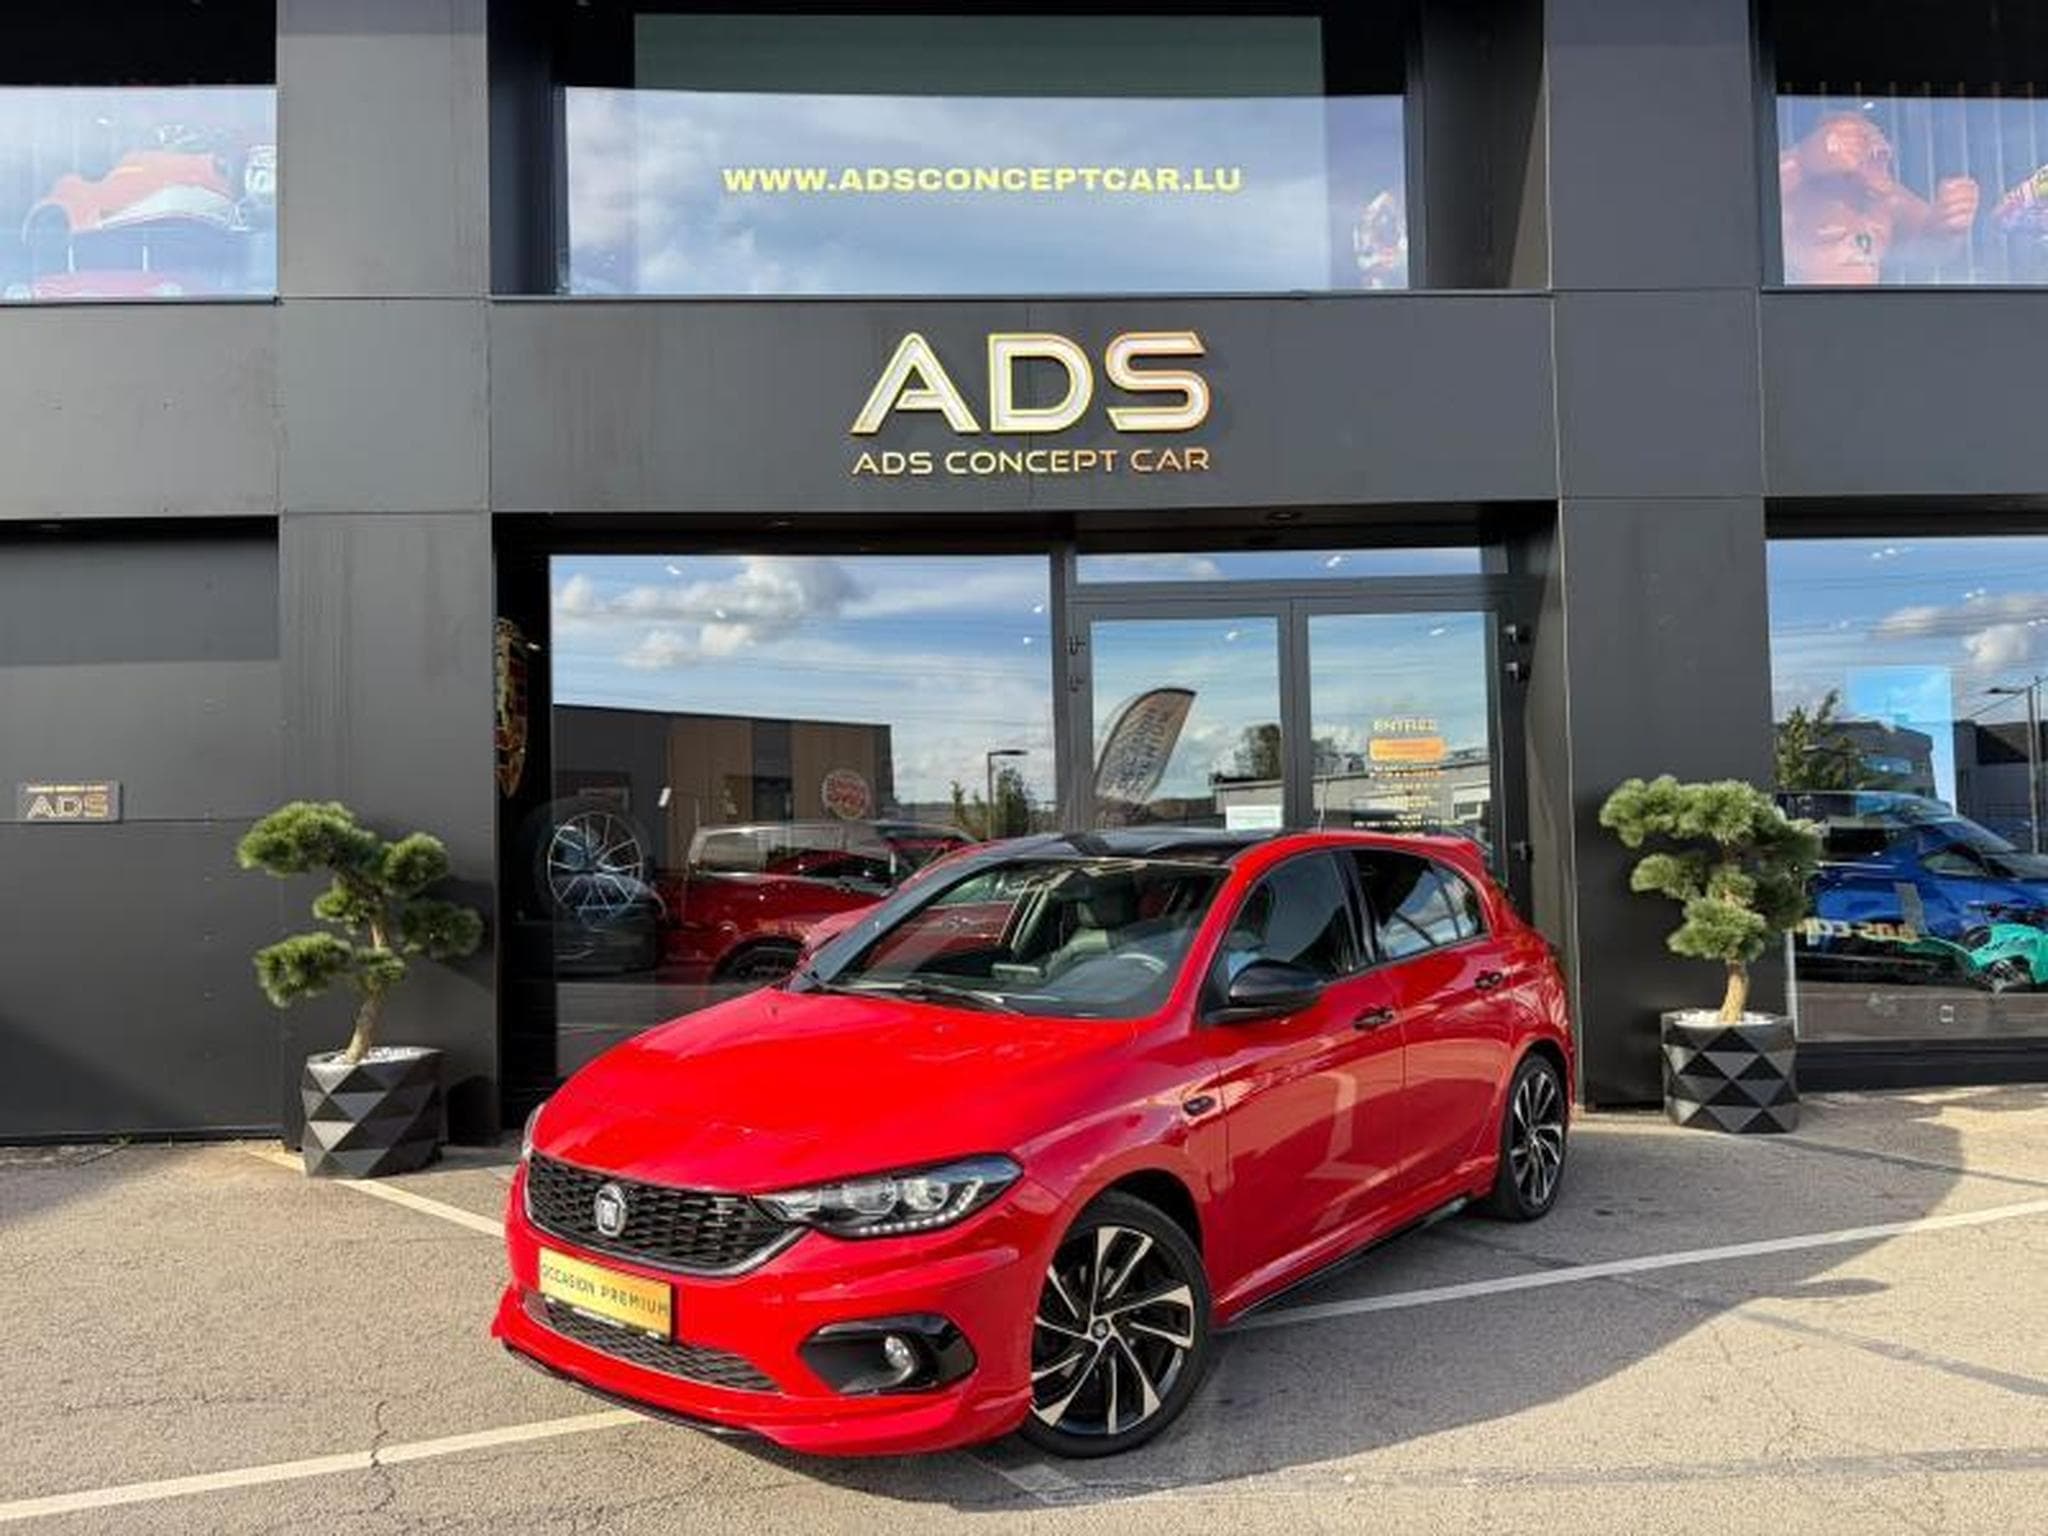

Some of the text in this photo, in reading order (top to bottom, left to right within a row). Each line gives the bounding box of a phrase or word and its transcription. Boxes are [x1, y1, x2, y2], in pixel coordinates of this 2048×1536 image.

[723, 167, 1241, 193] WWW.ADSCONCEPTCAR.LU
[851, 331, 1211, 434] ADS
[851, 447, 1211, 475] ADS CONCEPT CAR
[27, 794, 108, 819] ADS
[600, 1284, 669, 1318] PREMIUM
